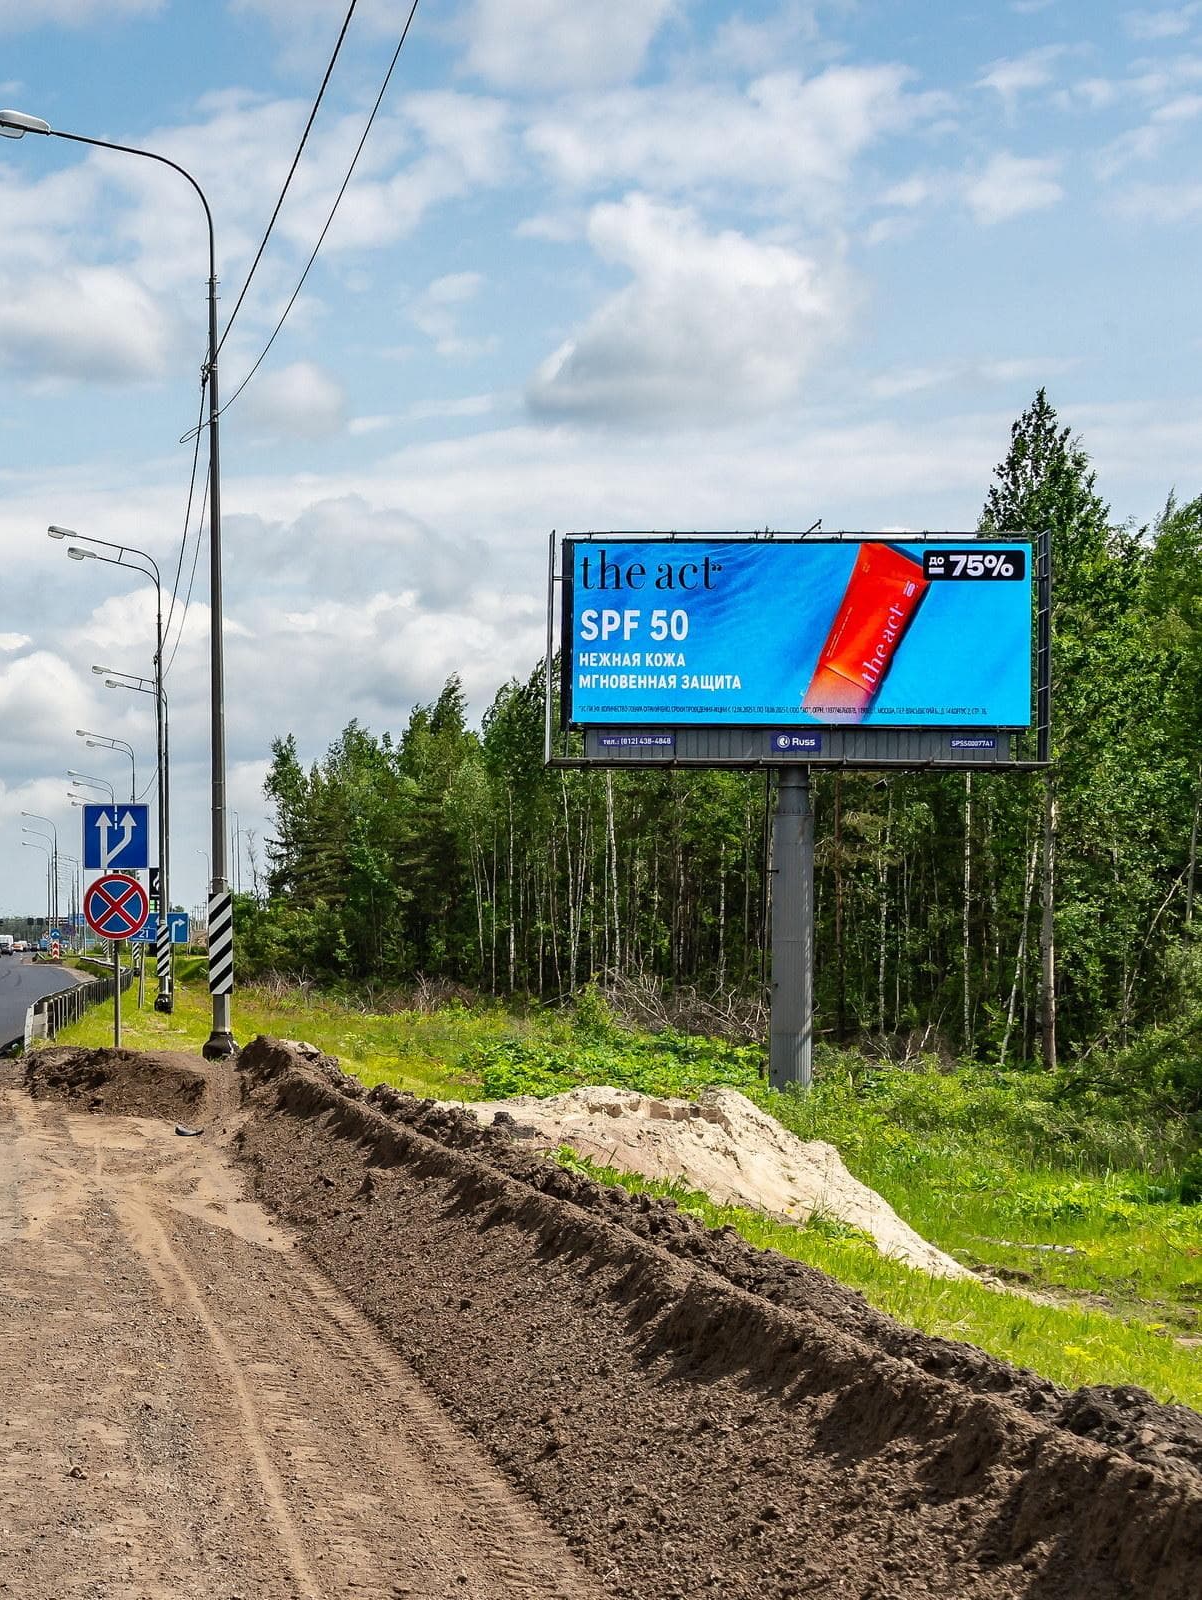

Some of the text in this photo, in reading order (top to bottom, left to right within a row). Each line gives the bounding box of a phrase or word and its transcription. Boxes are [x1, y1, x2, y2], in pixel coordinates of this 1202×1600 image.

[580, 550, 646, 590] the
[949, 555, 1014, 576] 75%
[580, 609, 689, 641] SPF 50
[579, 652, 686, 667] НЕЖНАЯ КОЖА
[861, 644, 888, 683] the
[579, 675, 742, 691] МГНОВЕННАЯ ЗАЩИТА
[792, 737, 816, 746] Russ
